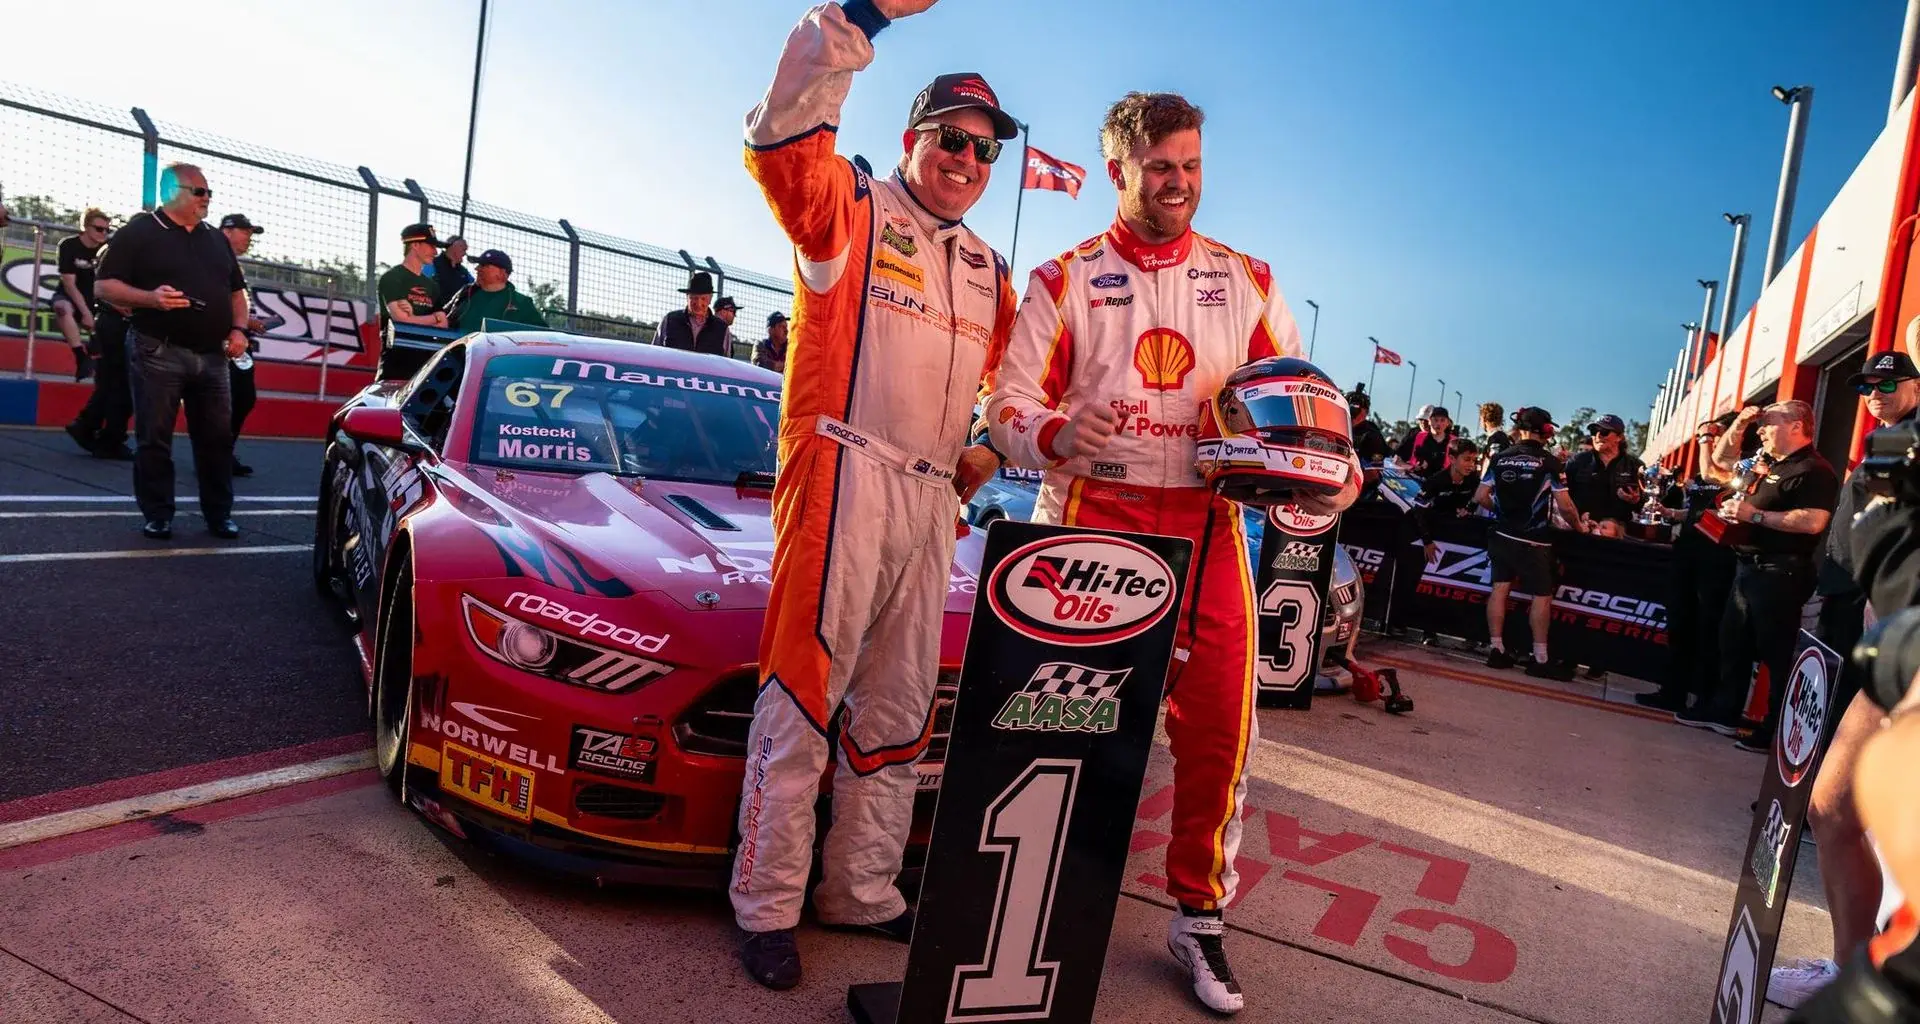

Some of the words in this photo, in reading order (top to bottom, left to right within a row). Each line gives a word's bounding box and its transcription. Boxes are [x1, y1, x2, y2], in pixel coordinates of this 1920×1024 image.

[1143, 257, 1177, 269] V-Power
[1200, 271, 1230, 279] PIRTEK
[1098, 276, 1122, 287] Ford
[1104, 294, 1135, 308] Repco
[504, 382, 574, 409] 67
[1300, 383, 1337, 401] Repco
[1110, 400, 1148, 415] Shell
[499, 424, 576, 439] Kostecki
[826, 423, 868, 447] sparco
[1115, 417, 1204, 438] V-Powe
[497, 438, 592, 463] Morris
[1233, 446, 1258, 455] PIRTEK
[1293, 515, 1315, 527] Oils
[1272, 552, 1320, 572] AASA
[1061, 558, 1166, 599] Hi-Tec
[1053, 594, 1114, 623] Oils
[504, 591, 670, 653] roadpod
[1258, 579, 1321, 692] 3
[991, 691, 1120, 733] AASA
[1796, 675, 1822, 734] Hi-Tec
[421, 712, 565, 775] NORWELL
[576, 728, 655, 761] TA2
[578, 751, 647, 771] RACING
[447, 751, 521, 811] TFH
[518, 776, 530, 809] HIRE
[745, 735, 773, 895] SUNENERGY
[945, 758, 1082, 1023] 1
